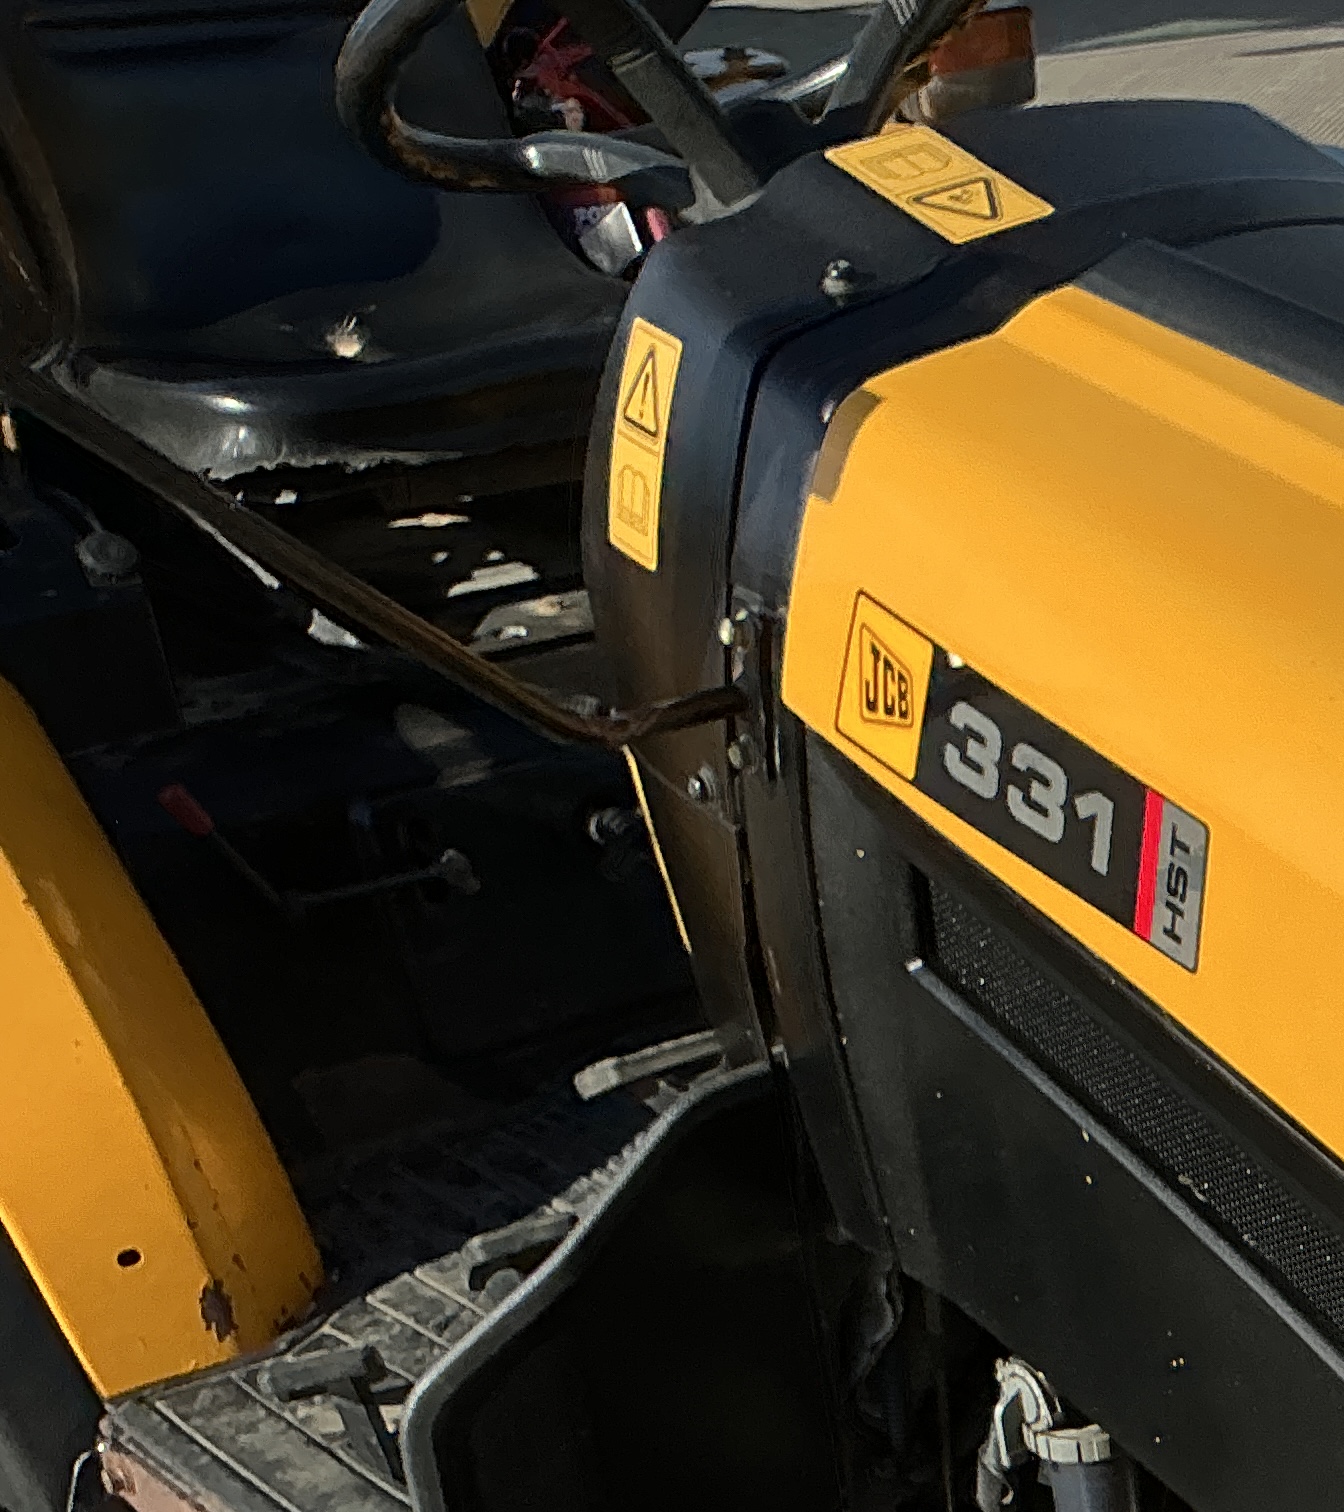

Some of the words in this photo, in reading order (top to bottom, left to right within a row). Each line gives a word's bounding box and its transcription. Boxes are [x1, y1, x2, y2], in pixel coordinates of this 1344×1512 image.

[864, 640, 910, 720] JCB
[943, 701, 1115, 876] 331
[1162, 823, 1192, 945] HST
